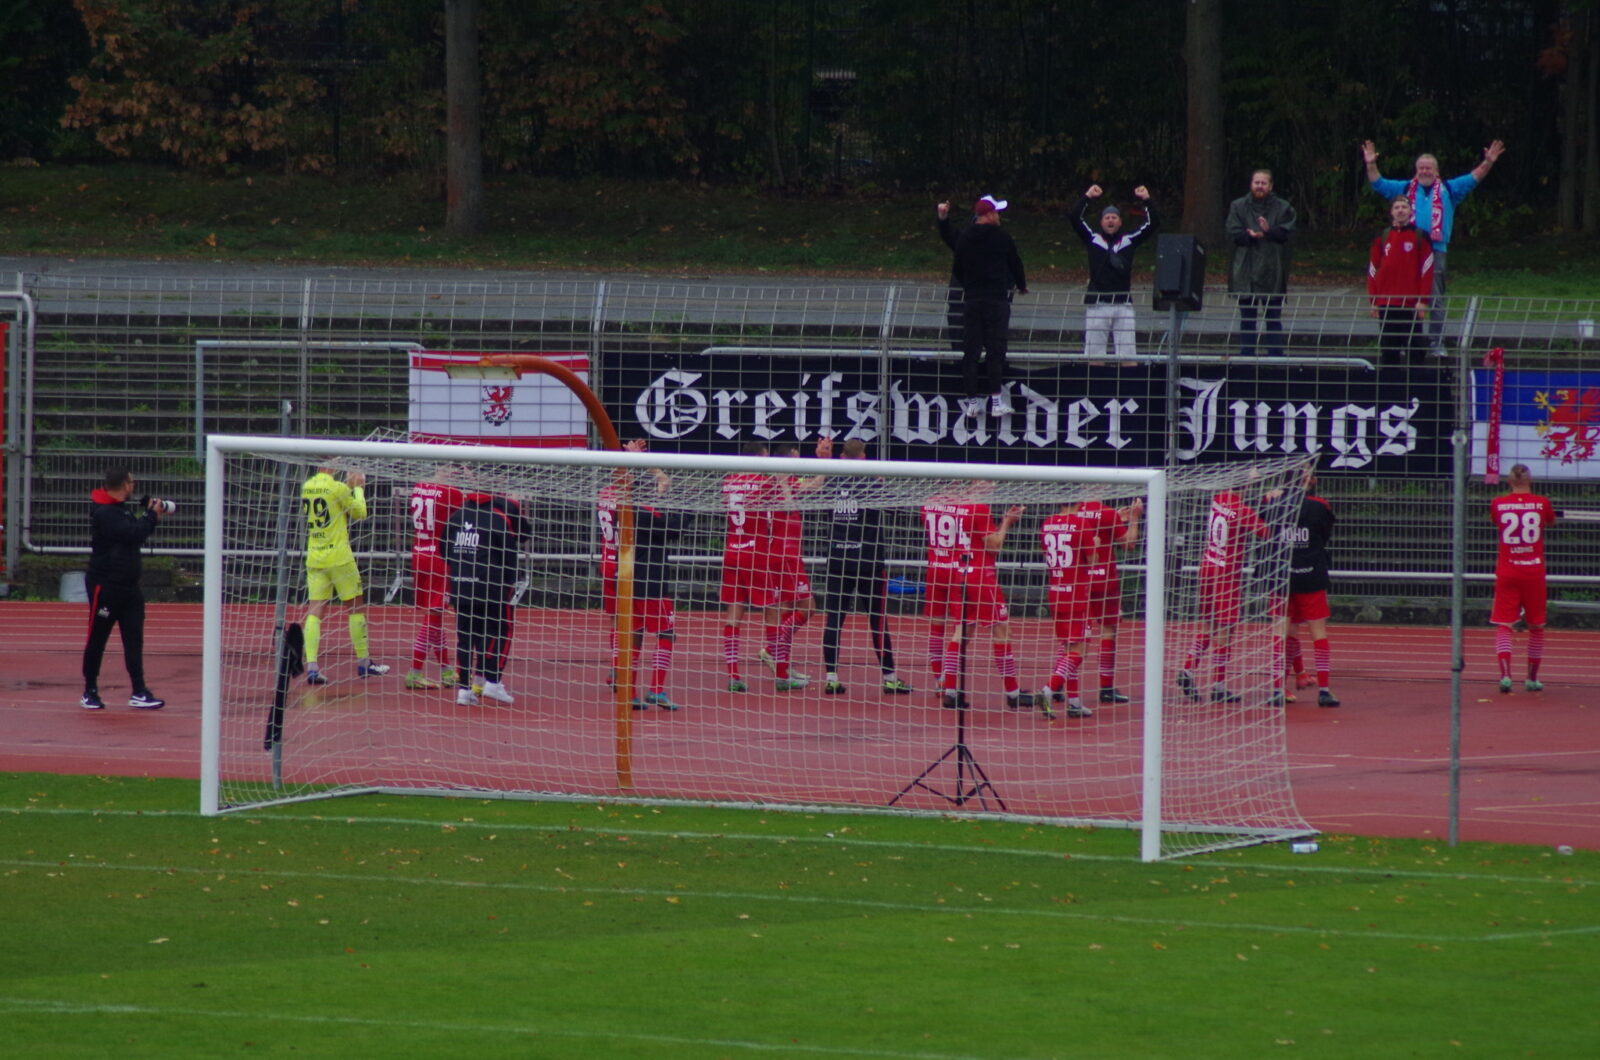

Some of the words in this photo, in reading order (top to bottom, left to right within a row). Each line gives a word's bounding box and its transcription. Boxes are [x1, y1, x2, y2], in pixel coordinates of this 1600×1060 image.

[635, 367, 1140, 450] Greifswalder
[1175, 376, 1420, 468] Jungs
[302, 497, 332, 529] 29
[411, 496, 435, 531] 21
[729, 493, 746, 526] 5
[454, 532, 480, 548] JOHO
[925, 513, 957, 548] 19
[1500, 511, 1541, 545] 28
[1044, 533, 1073, 568] 35
